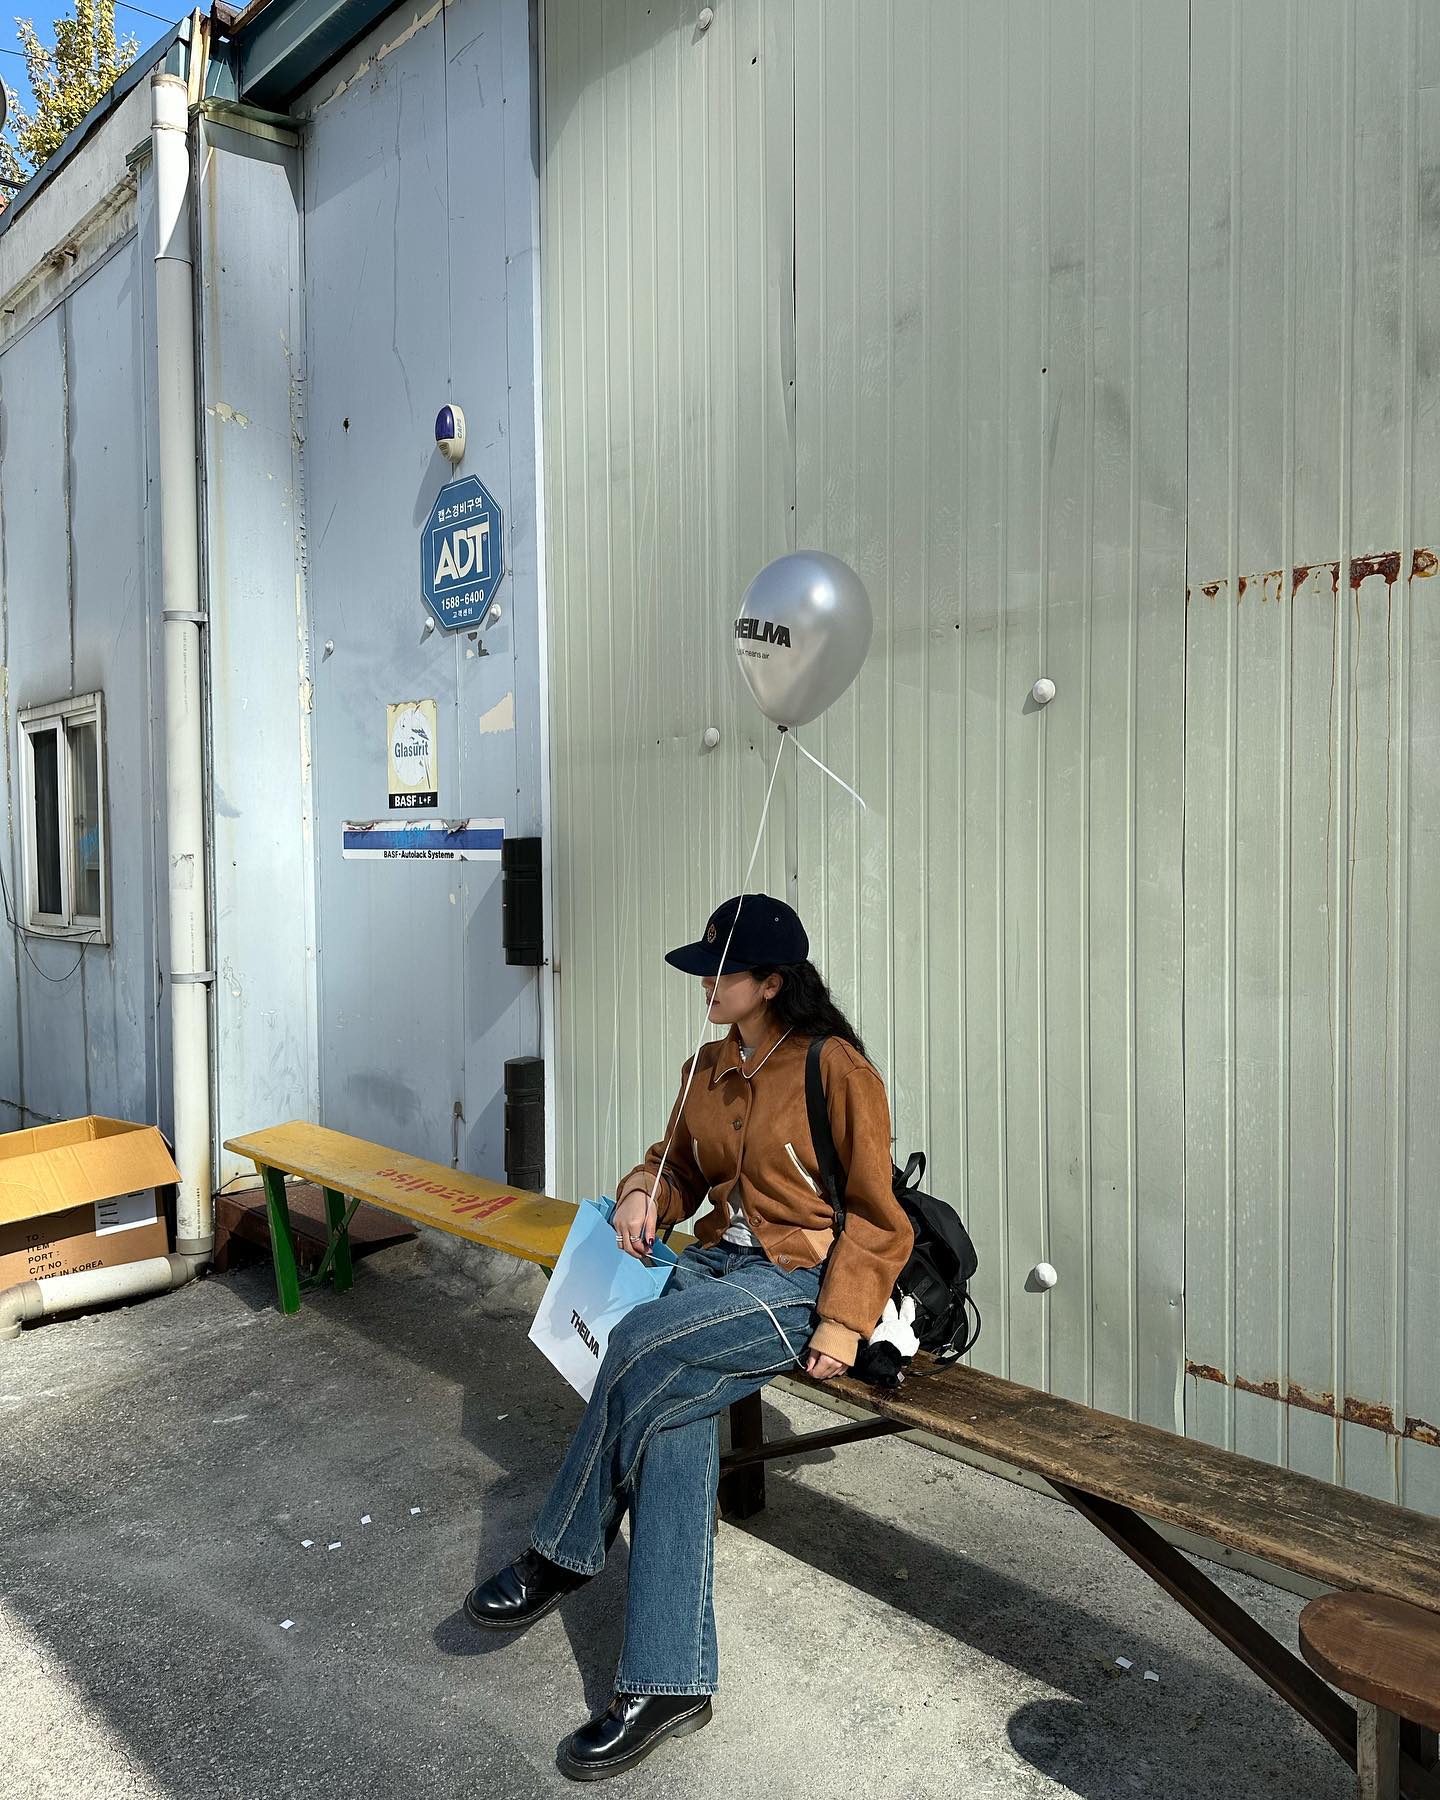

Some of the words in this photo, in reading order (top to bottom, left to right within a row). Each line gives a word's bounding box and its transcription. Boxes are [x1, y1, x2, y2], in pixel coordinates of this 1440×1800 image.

[438, 496, 482, 523] 캡스경비구역
[435, 522, 489, 584] ADT
[441, 589, 484, 611] 1588-6400
[734, 618, 791, 648] HEILMA
[395, 740, 428, 758] Glasurit
[394, 795, 416, 807] BASF
[428, 850, 454, 859] Systeme
[26, 1234, 38, 1242] TO
[28, 1251, 53, 1263] PORT
[29, 1264, 45, 1274] C/T
[48, 1261, 62, 1269] NO
[72, 1259, 103, 1273] KOREA
[569, 1309, 600, 1359] THEILMA
